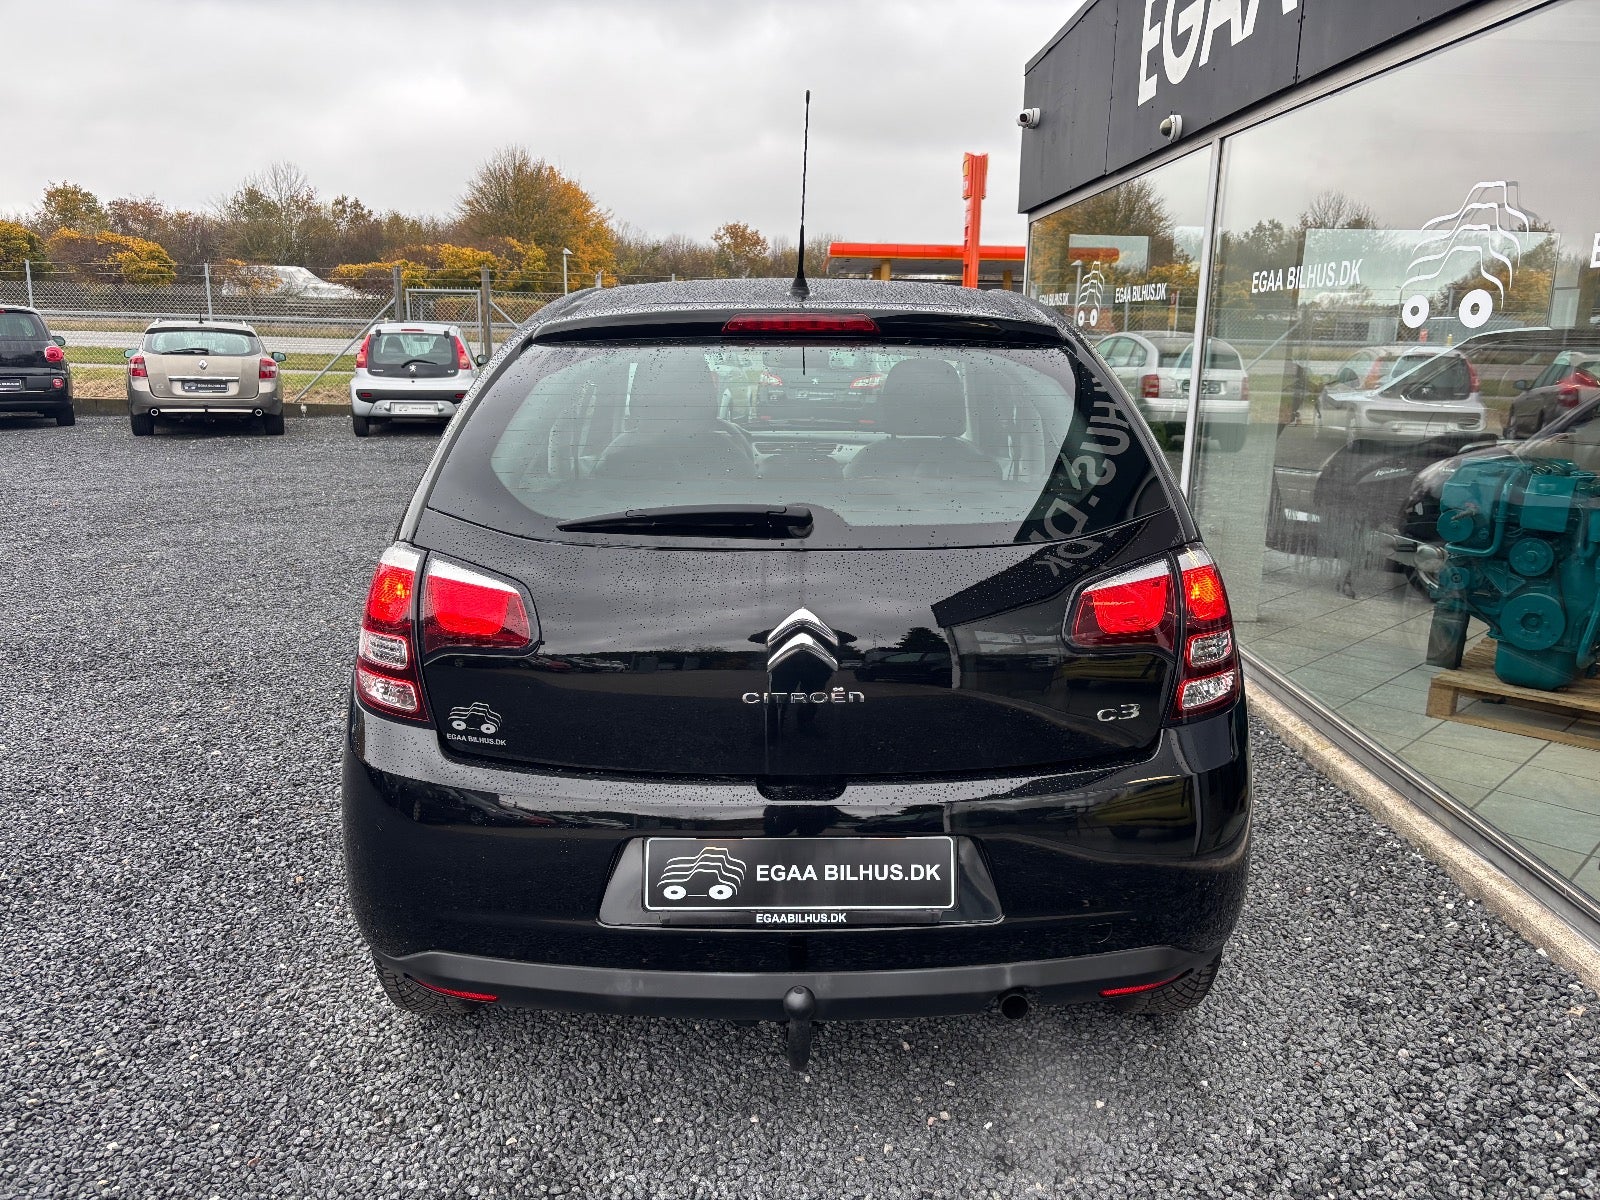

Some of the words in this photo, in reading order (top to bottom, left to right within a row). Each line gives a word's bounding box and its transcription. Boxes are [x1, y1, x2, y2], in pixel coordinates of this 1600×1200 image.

[1251, 268, 1284, 294] EGAA
[1286, 258, 1364, 290] BILHUS.DK
[1114, 286, 1131, 304] EGAA
[1132, 282, 1168, 302] BILHUS.DK
[1096, 703, 1141, 722] C3
[446, 732, 467, 742] EGAA
[467, 735, 507, 746] BILHUS.DK
[755, 863, 818, 882] EGAA
[824, 863, 941, 882] BILHUS.DK
[755, 912, 847, 924] EGAABILHUS.DK
